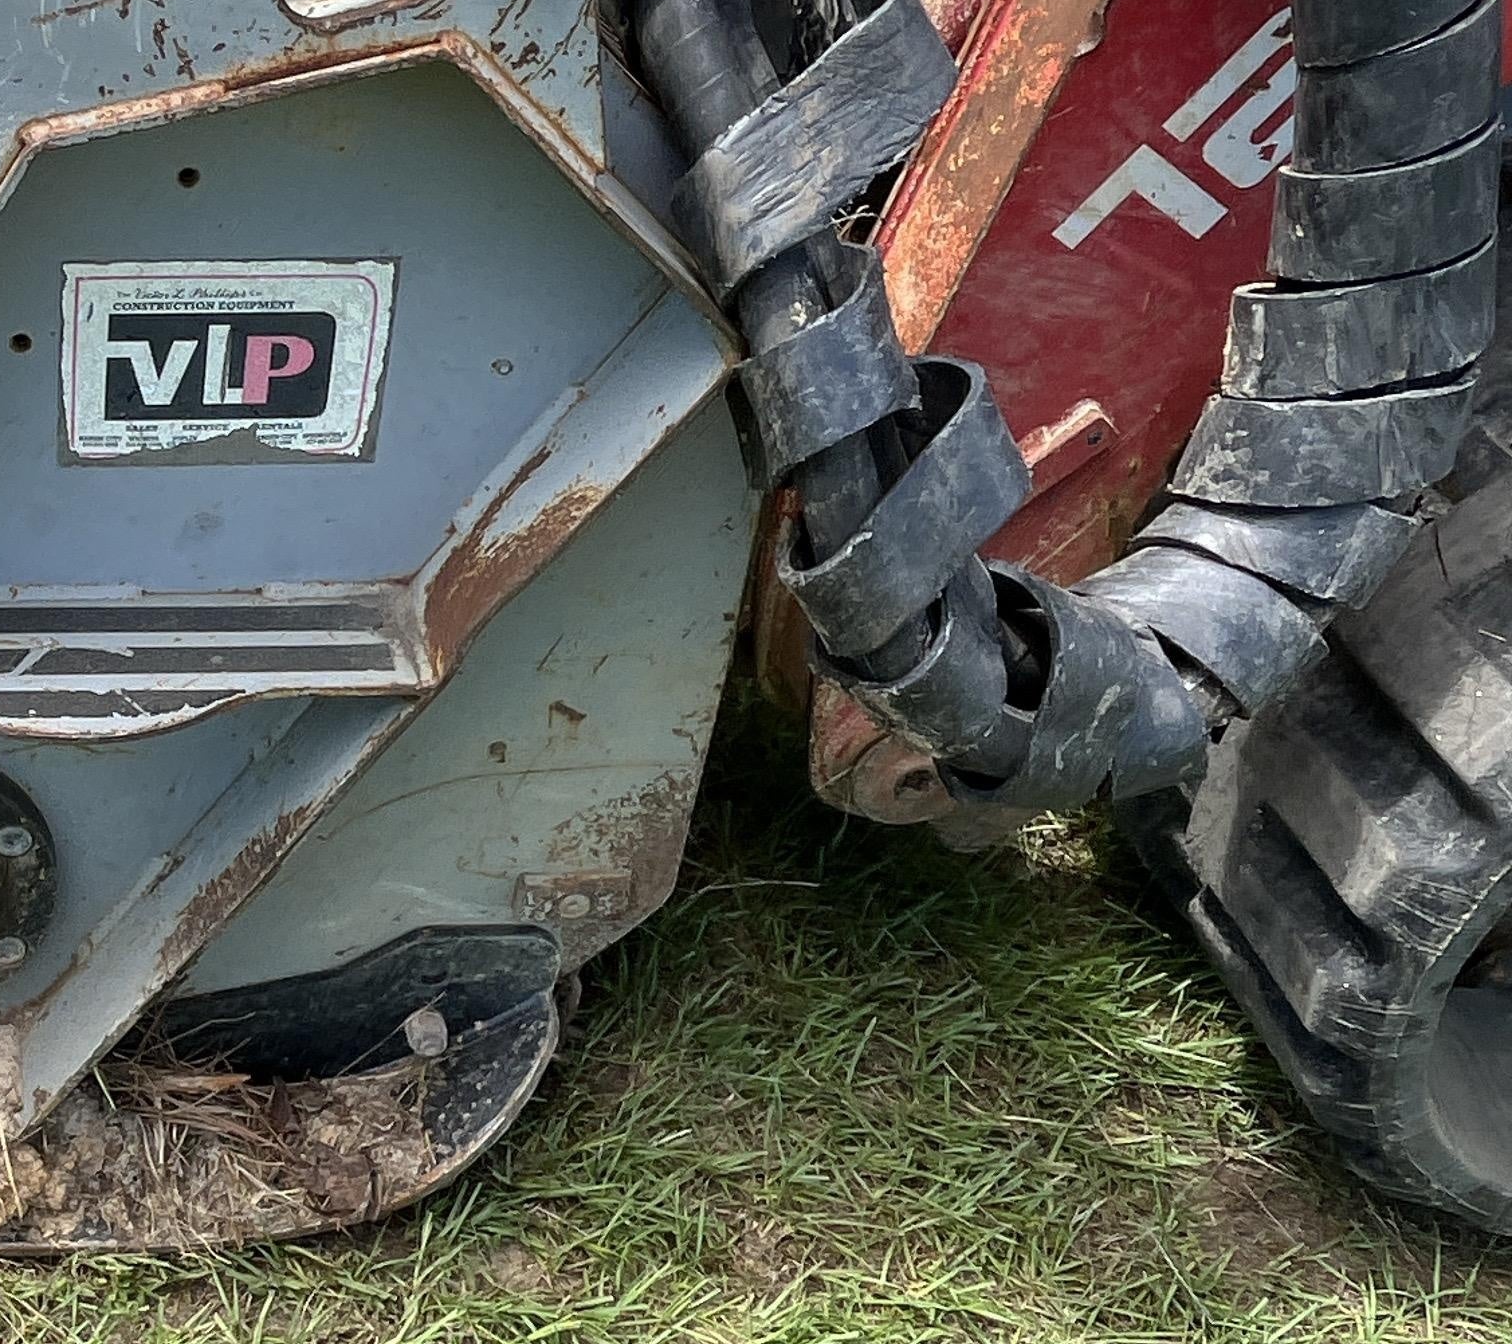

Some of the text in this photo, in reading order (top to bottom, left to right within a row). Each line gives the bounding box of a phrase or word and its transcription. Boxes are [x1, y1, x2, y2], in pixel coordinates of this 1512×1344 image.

[113, 300, 295, 312] CONSTRUCTION EQUIPMENT
[106, 324, 316, 406] VLP
[182, 424, 229, 432] SERVICE
